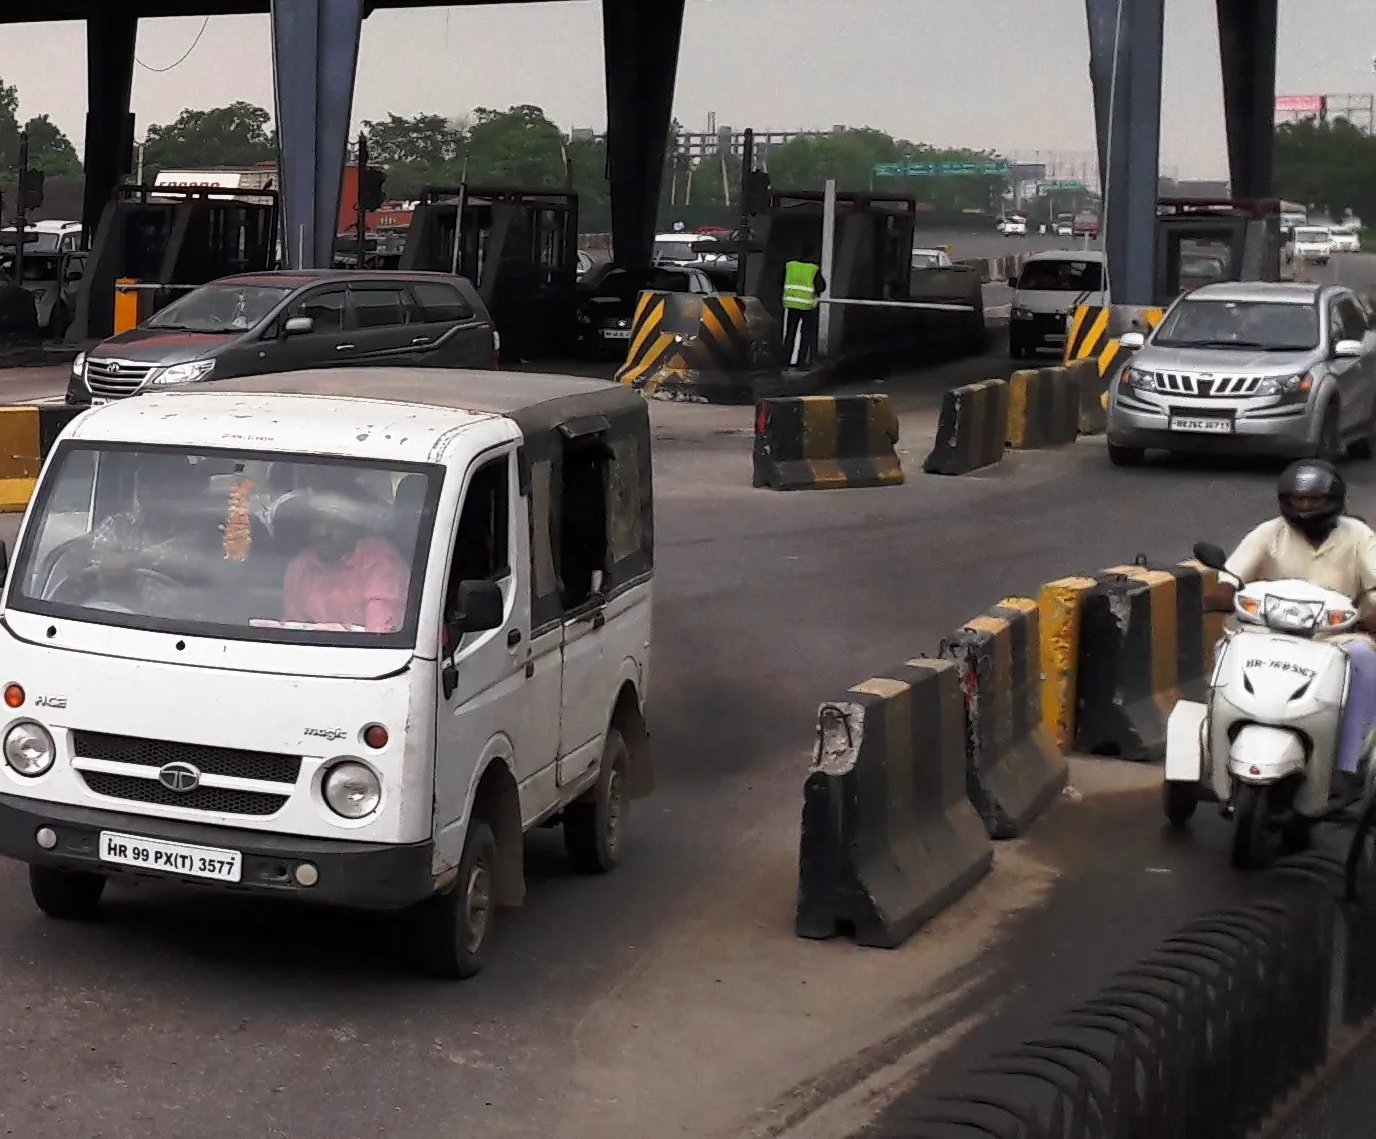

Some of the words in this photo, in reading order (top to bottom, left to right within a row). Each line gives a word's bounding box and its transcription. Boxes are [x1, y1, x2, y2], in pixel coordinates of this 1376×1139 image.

[34, 694, 68, 709] ACE
[107, 841, 128, 858] HR
[132, 847, 149, 862] 99
[154, 850, 193, 871] PX(T)
[198, 857, 234, 875] 3577
